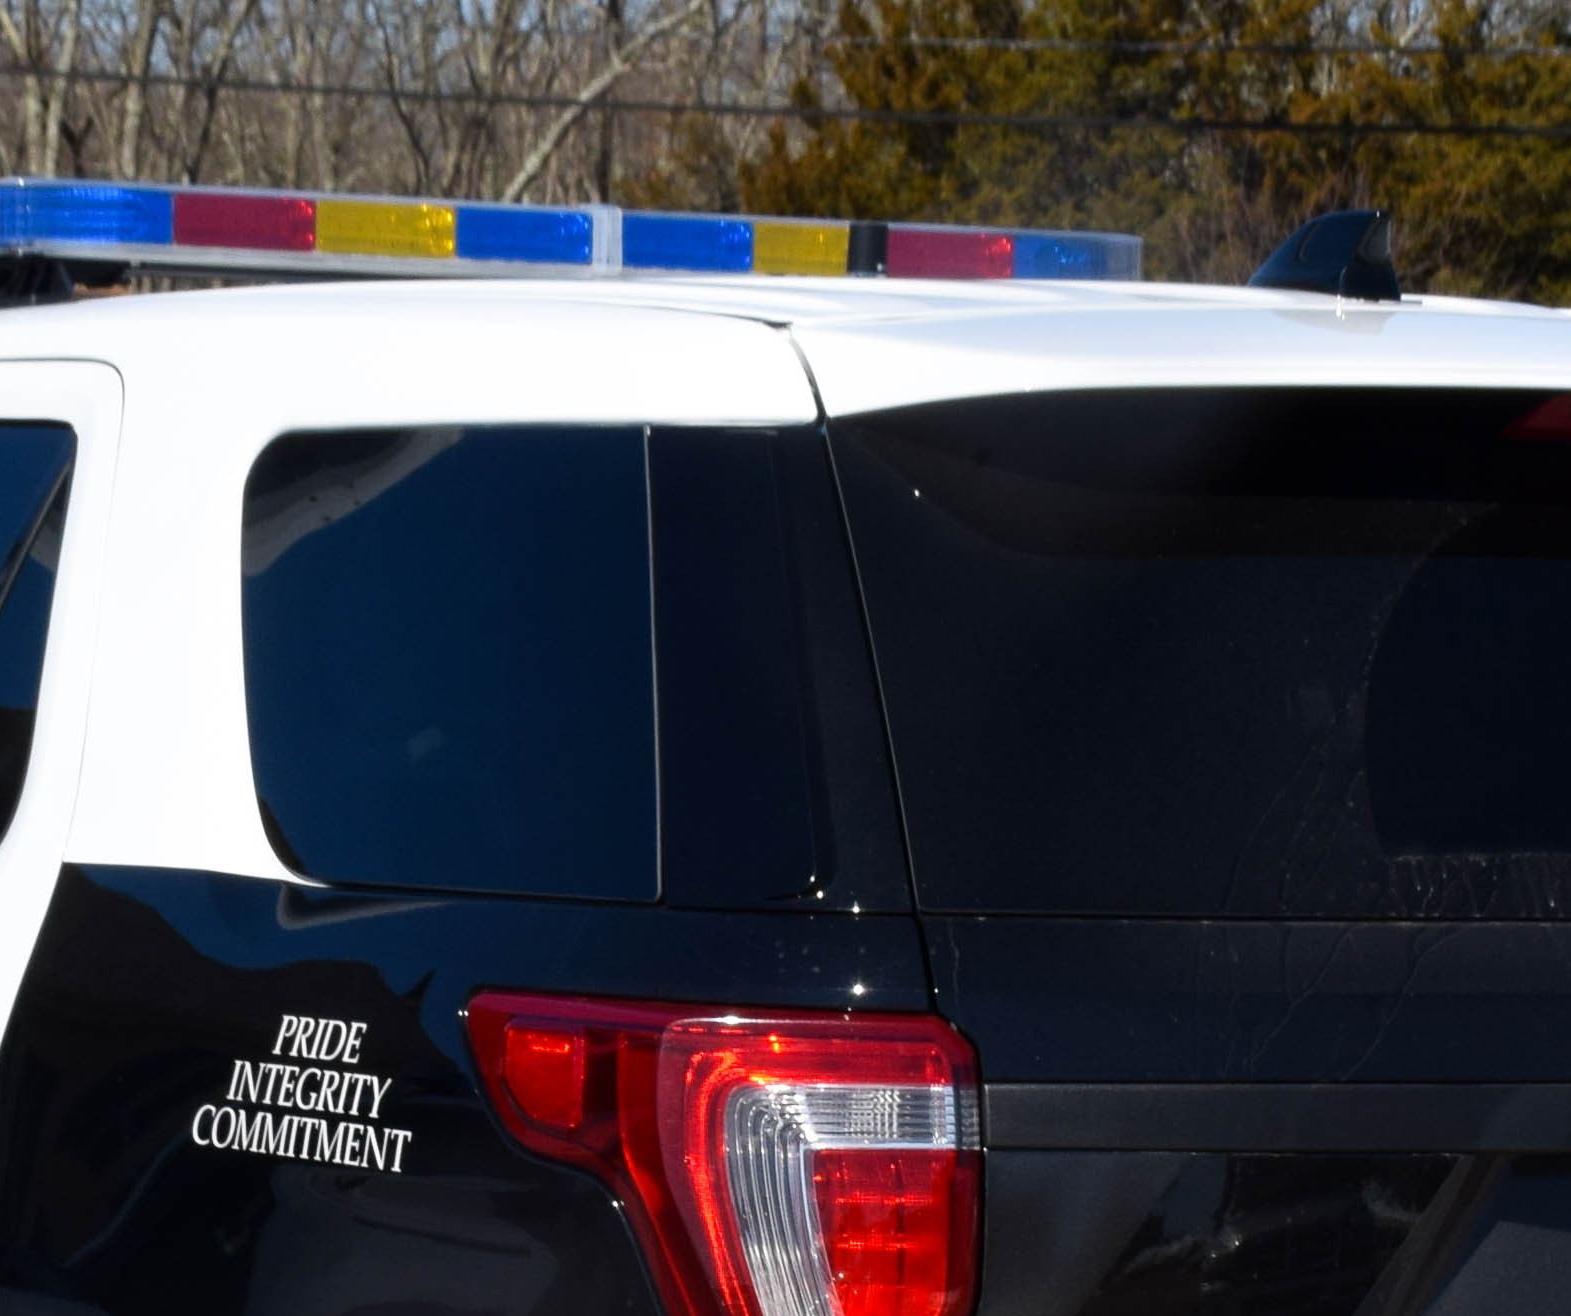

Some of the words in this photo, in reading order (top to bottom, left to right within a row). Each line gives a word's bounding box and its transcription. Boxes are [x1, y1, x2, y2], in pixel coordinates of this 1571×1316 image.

[272, 1014, 367, 1064] PRIDE
[226, 1060, 392, 1119] INTEGRITY
[192, 1104, 413, 1173] COMMITMENT
